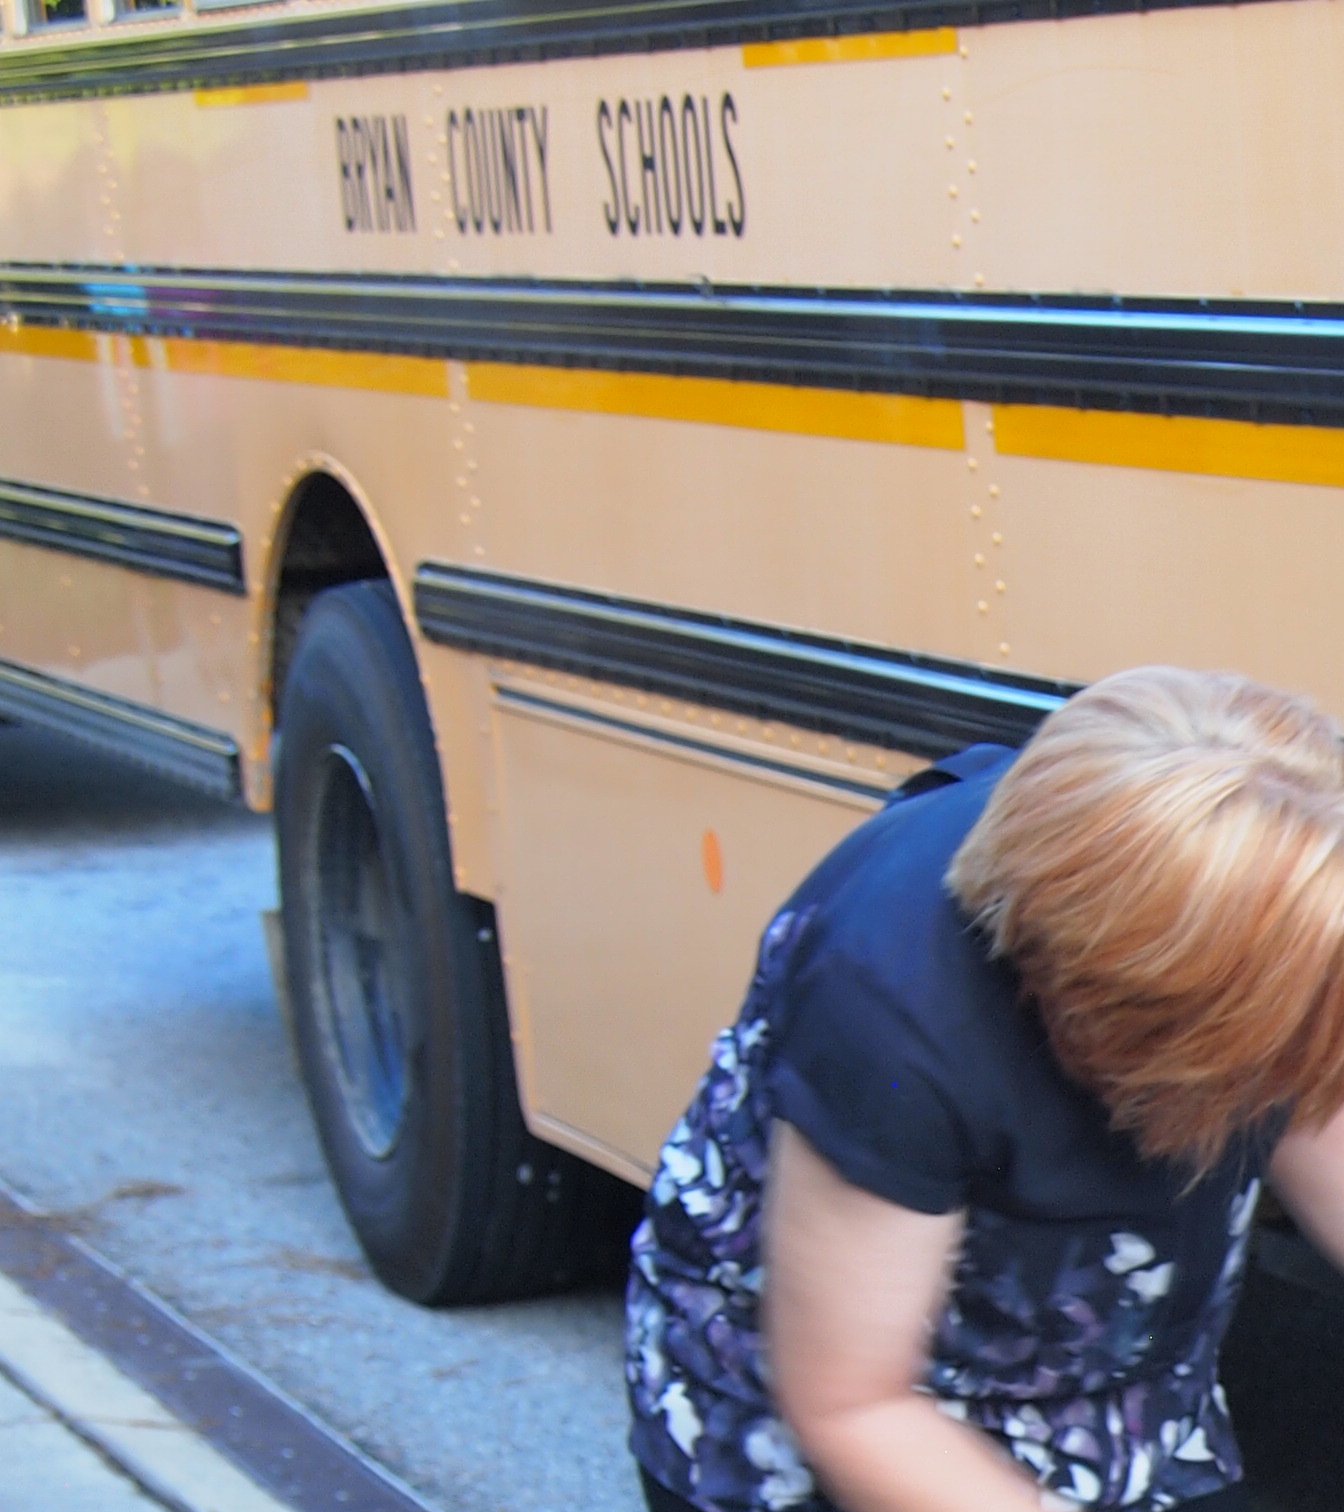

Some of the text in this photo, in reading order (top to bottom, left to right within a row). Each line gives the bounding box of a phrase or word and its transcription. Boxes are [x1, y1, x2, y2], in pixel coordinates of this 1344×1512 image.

[335, 91, 746, 238] BRYAN COUNTY SCHOOLS
